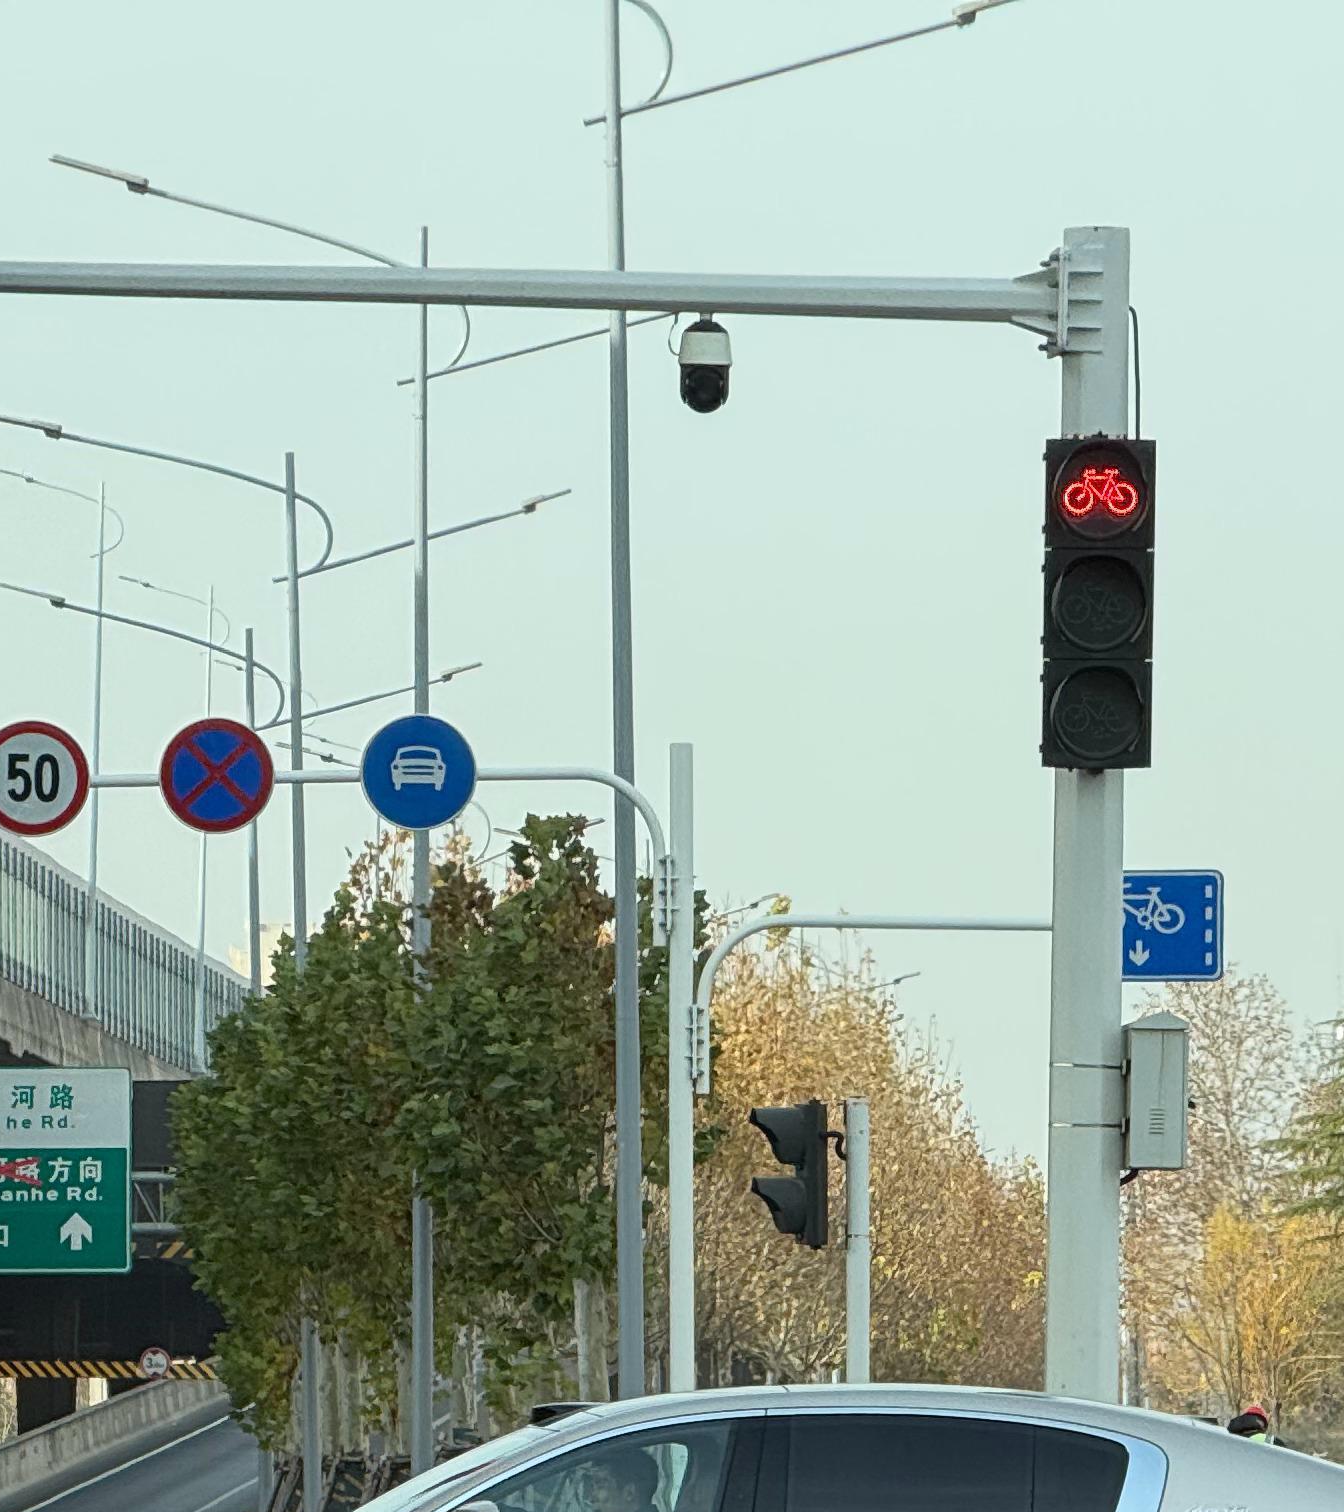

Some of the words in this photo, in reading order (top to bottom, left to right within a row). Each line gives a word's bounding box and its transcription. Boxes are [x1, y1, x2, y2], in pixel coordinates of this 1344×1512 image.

[6, 753, 59, 803] 50
[41, 1115, 76, 1129] Rd.
[67, 1186, 103, 1202] Rd.
